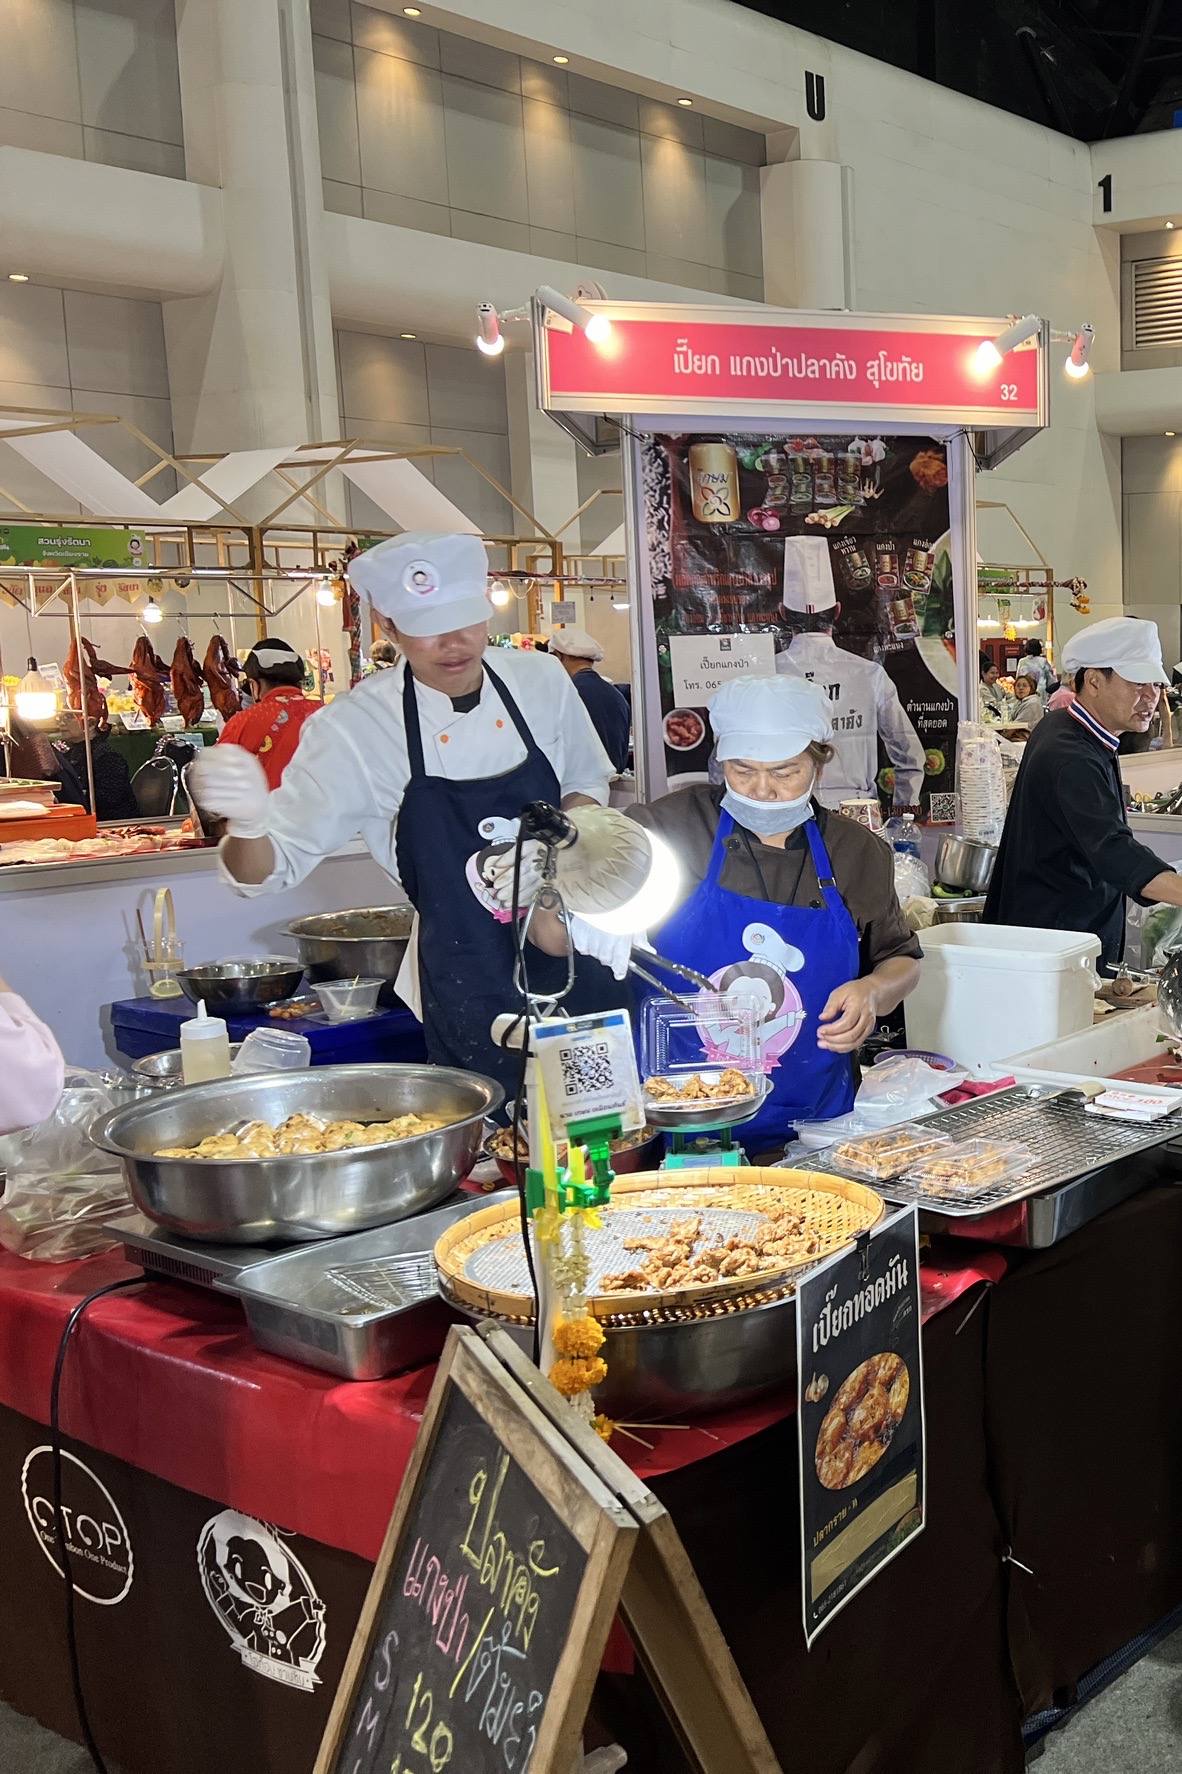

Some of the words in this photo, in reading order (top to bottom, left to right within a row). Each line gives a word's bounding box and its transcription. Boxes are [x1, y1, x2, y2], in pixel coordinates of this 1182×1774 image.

[804, 70, 826, 122] U
[1097, 174, 1112, 213] 1
[673, 338, 720, 375] เปี๊ยก
[729, 346, 857, 381] แกงป่าปลาคัง
[866, 350, 924, 390] สุโขทัย
[1000, 384, 1018, 401] 32
[37, 536, 91, 548] สวนรุ่งรัตนา
[876, 541, 896, 551] แกงป่า
[700, 656, 750, 670] เปี๊ยกแกงป่า
[683, 679, 703, 690] โทร.
[906, 698, 954, 712] ตำนานแกงป่า
[917, 711, 948, 733] ที่สุดยอด
[812, 1253, 909, 1354] เปี๊ยกทอดมัน
[32, 1496, 122, 1555] OTOP
[84, 1547, 100, 1564] One
[459, 1450, 561, 1653] ปลาคัง
[374, 1630, 399, 1691] S
[405, 1671, 453, 1773] 120
[356, 1696, 382, 1751] M
